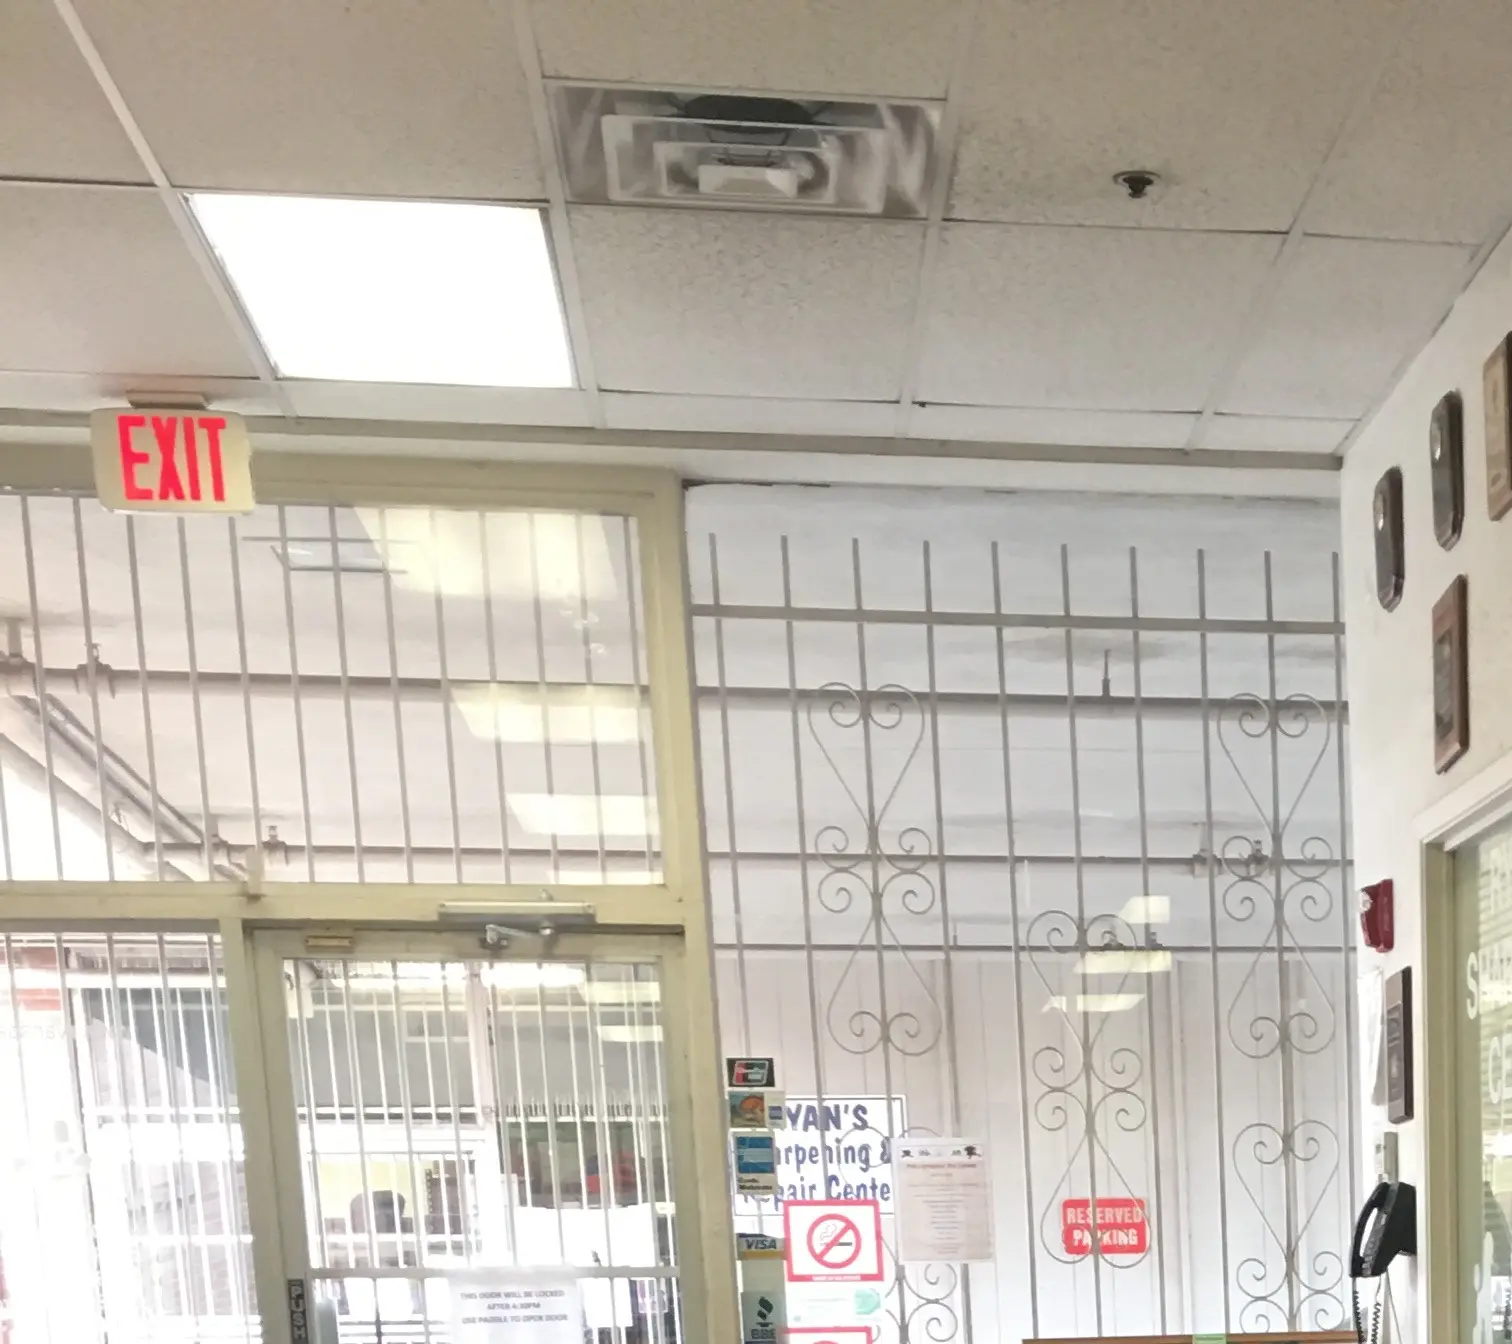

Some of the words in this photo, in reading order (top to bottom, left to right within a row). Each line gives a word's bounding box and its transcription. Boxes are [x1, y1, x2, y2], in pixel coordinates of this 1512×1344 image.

[118, 415, 227, 502] EXIT
[785, 1104, 868, 1132] YAN'S
[774, 1137, 872, 1173] rpening
[828, 1174, 891, 1201] Cente
[1066, 1207, 1143, 1225] RESERVED
[745, 1239, 777, 1250] VISA
[292, 1285, 306, 1340] PUSH
